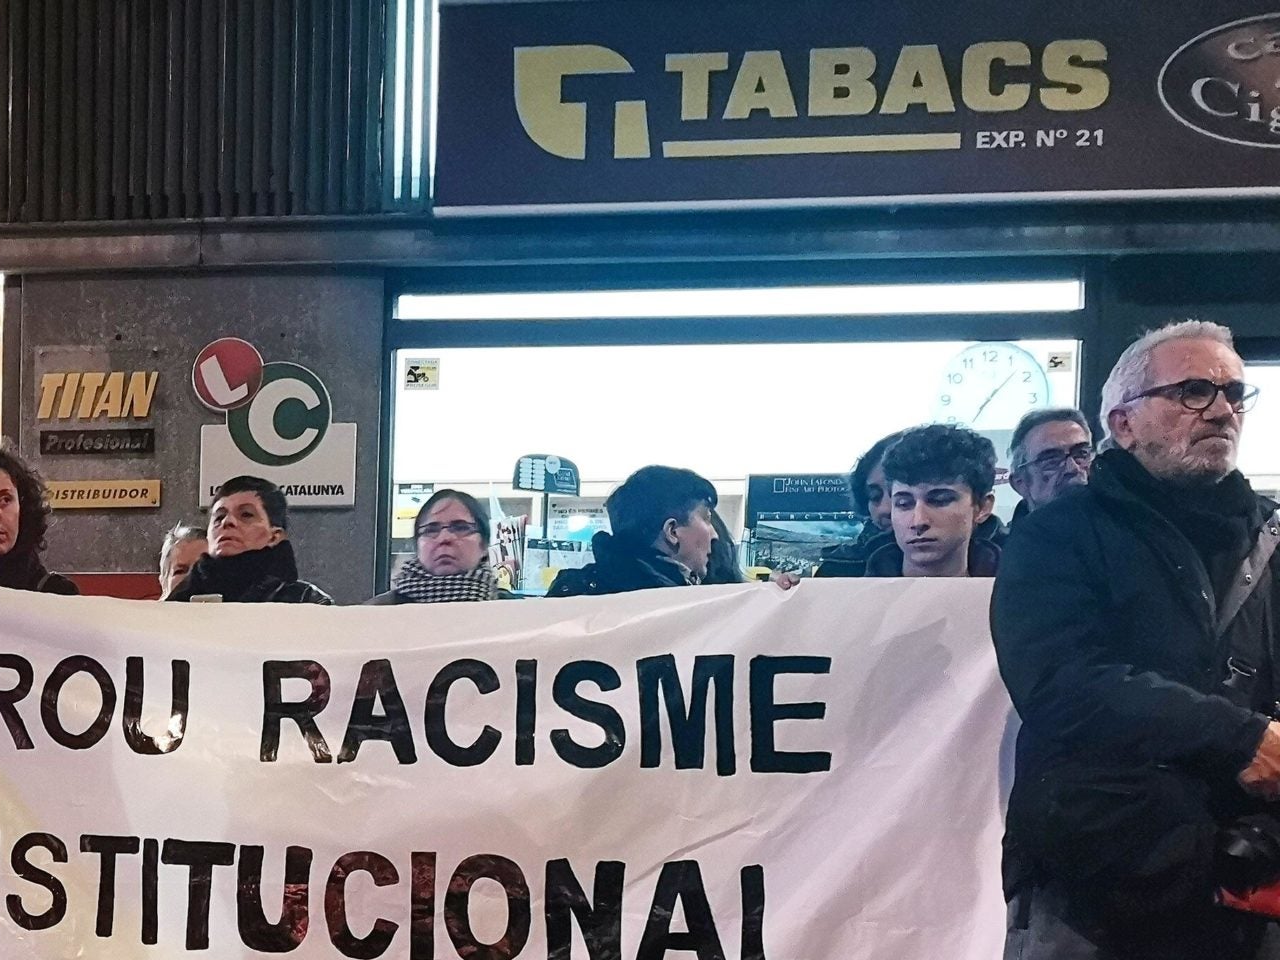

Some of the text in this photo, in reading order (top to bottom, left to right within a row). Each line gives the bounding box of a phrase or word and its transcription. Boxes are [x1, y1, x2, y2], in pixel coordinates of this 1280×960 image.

[664, 39, 1110, 121] TABACS
[976, 130, 1026, 149] EXP.
[1075, 128, 1104, 147] 21
[982, 350, 998, 362] 12
[1008, 355, 1013, 366] 1
[963, 358, 974, 368] 11
[947, 372, 963, 384] 10
[1022, 371, 1032, 383] 2
[37, 371, 159, 420] TITAN
[940, 394, 951, 406] 9
[1028, 392, 1038, 404] 3
[45, 432, 150, 451] Profesional
[50, 488, 149, 500] ISTRIBUIDOR
[259, 653, 832, 777] RACISME
